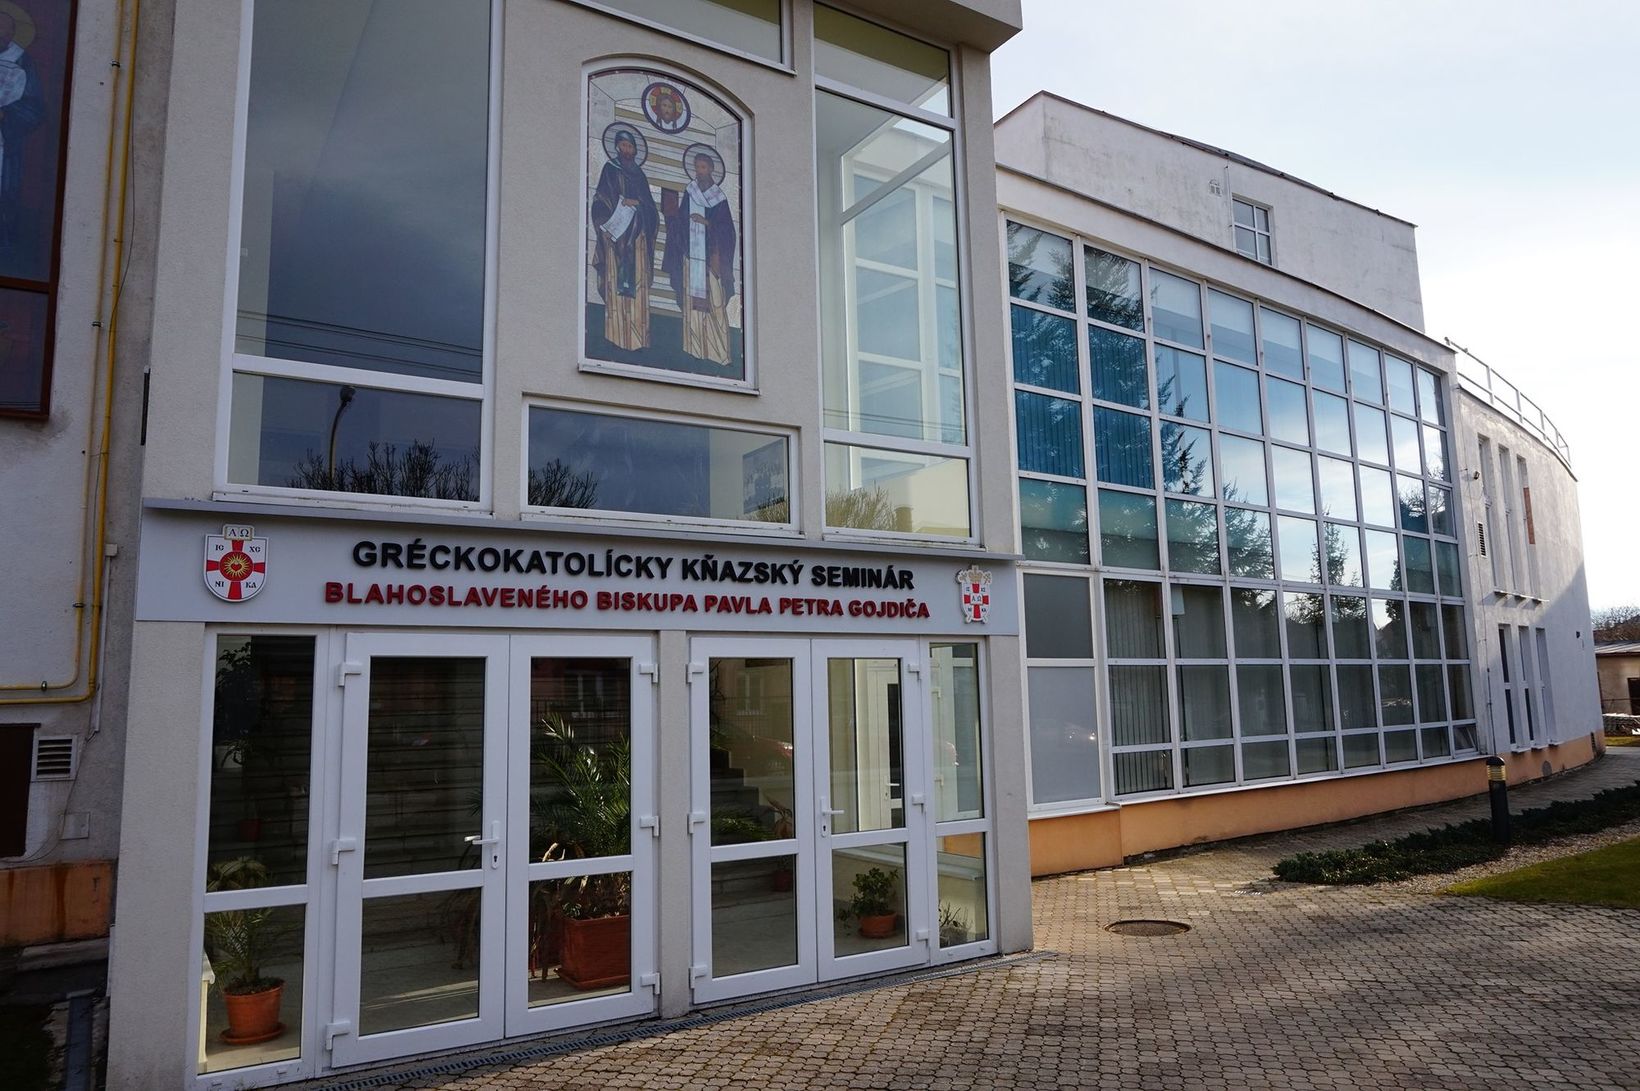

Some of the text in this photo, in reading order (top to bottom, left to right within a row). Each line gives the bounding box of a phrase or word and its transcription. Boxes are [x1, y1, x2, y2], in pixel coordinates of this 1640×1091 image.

[353, 538, 915, 590] GRÉCKOKATOLÍCKY KŇAZSKÝ SEMINÁR
[325, 581, 930, 619] BLAHOSLAVENÉHO BISKUPA PAVLA PETRA GOJDIČA
